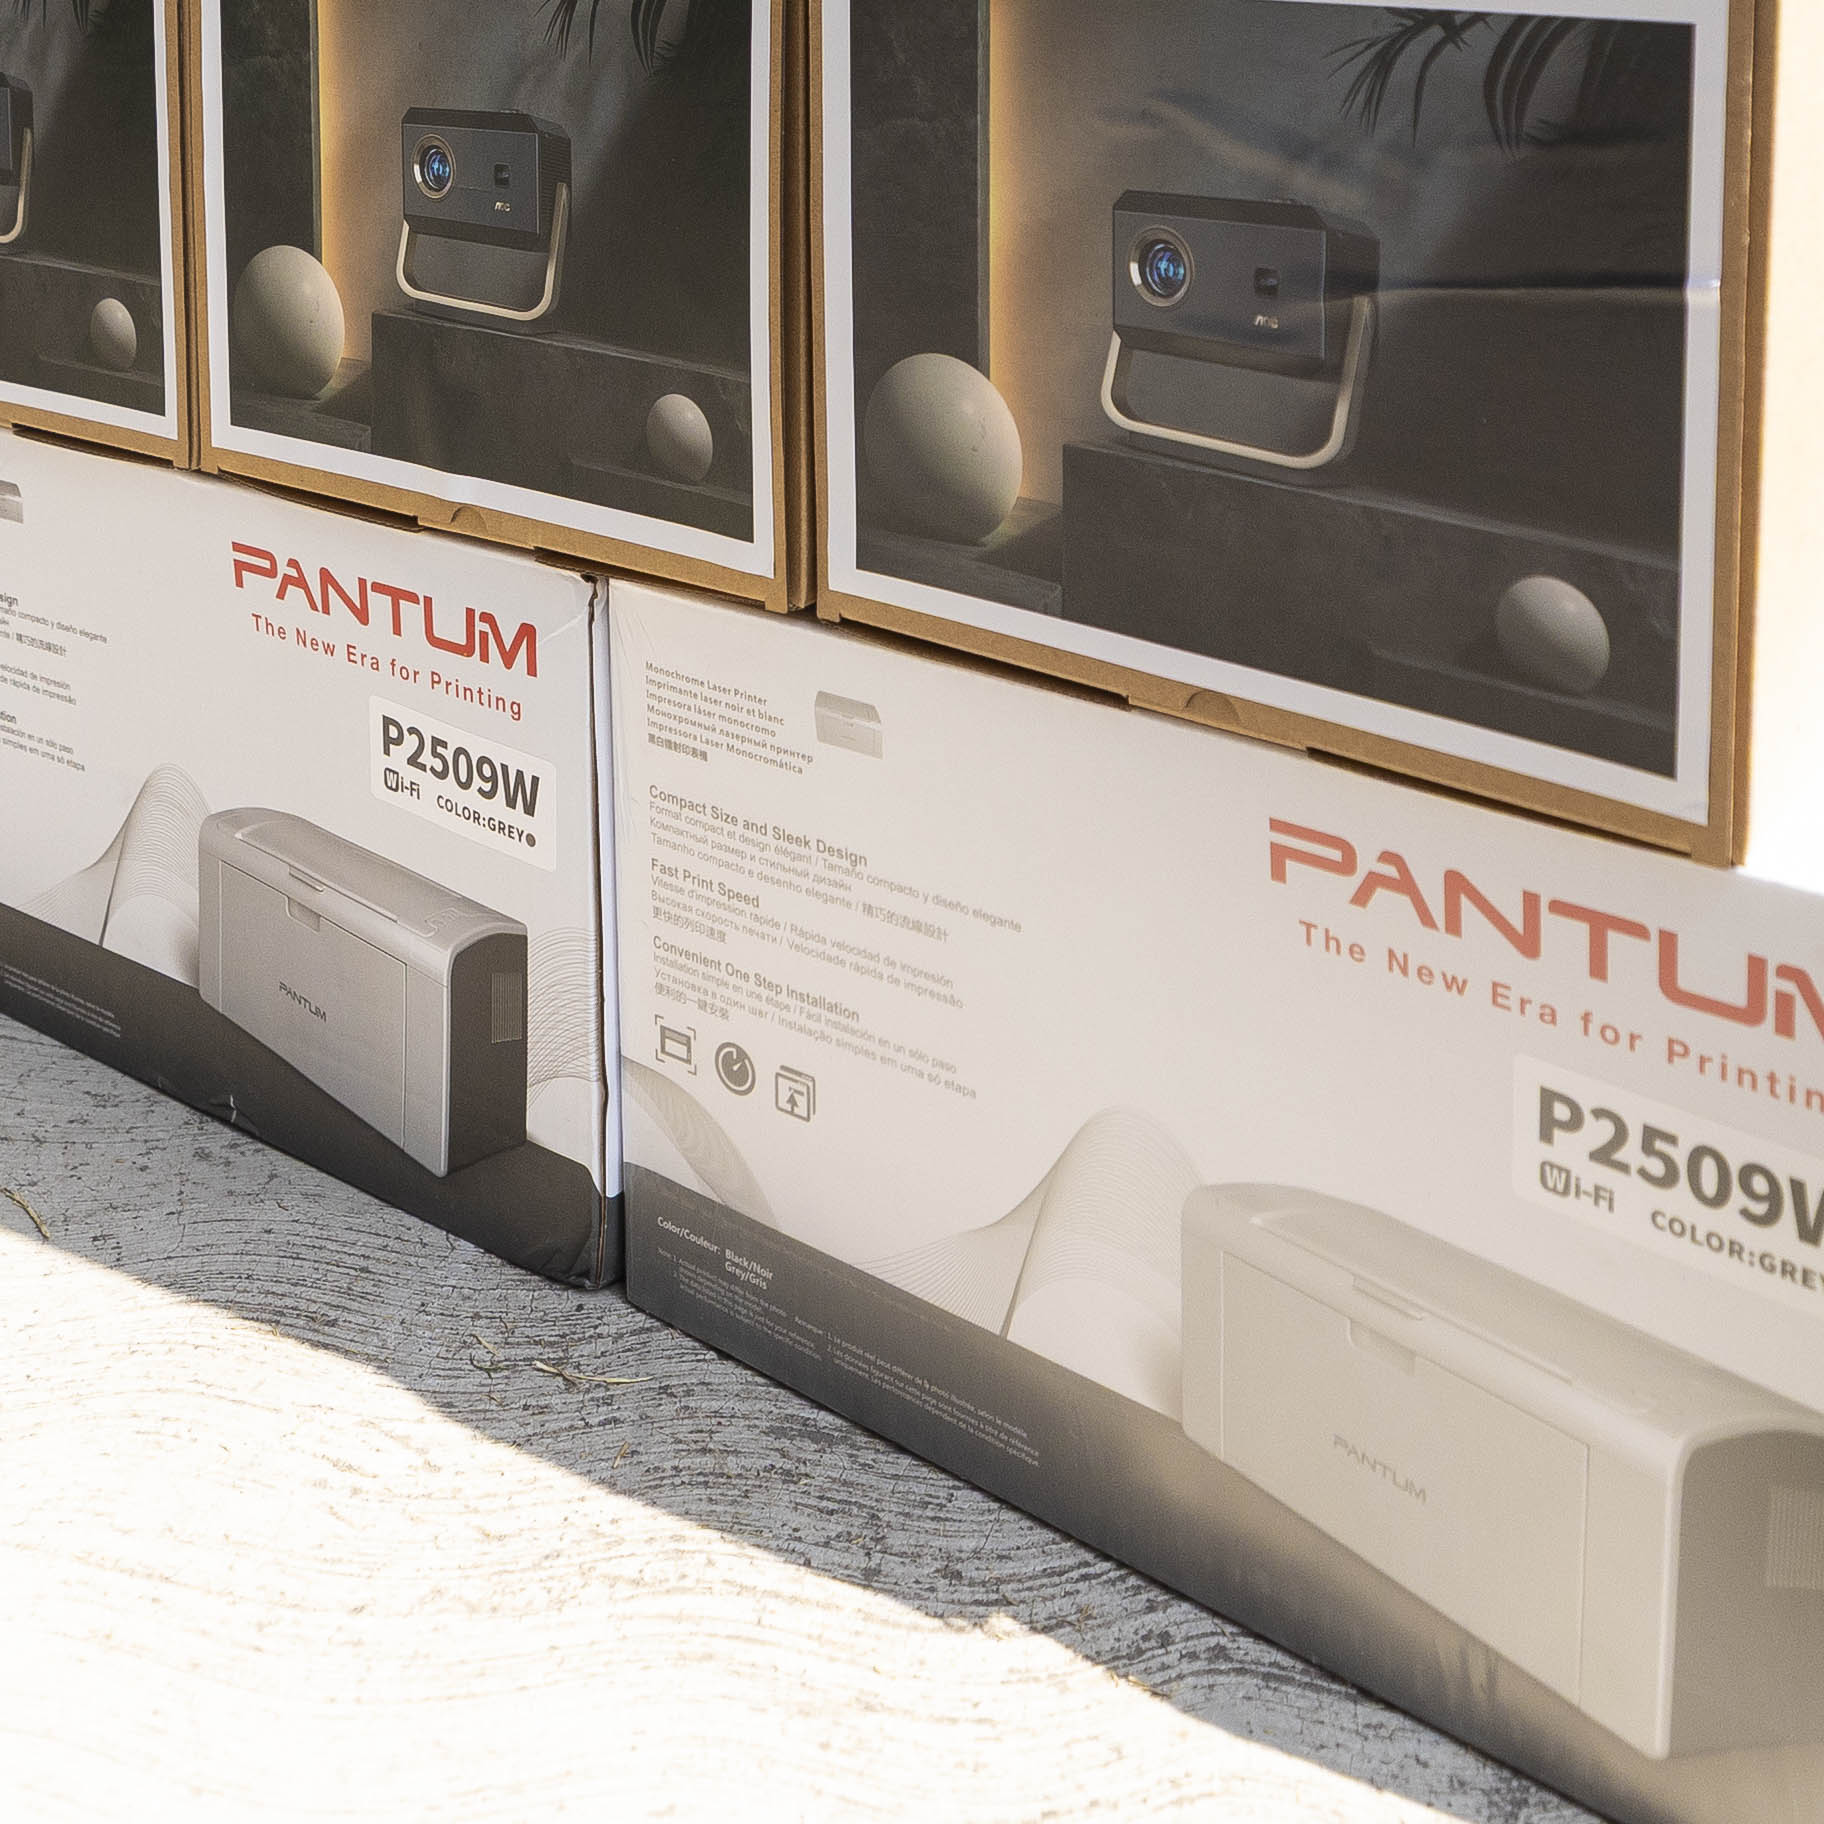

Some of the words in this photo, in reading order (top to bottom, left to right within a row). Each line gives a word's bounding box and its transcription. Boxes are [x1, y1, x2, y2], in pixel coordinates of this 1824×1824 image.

[232, 541, 537, 678] PANTUM
[252, 613, 286, 641] The
[296, 629, 335, 657] New
[347, 644, 380, 671] Era
[390, 658, 420, 684] for
[431, 672, 522, 721] Printing
[646, 662, 704, 687] Monochrome
[707, 680, 731, 695] Laser
[734, 689, 767, 706] Printer
[646, 675, 698, 699] Imprimante
[700, 692, 722, 707] laser
[725, 701, 744, 714] noir
[746, 707, 756, 717] et
[758, 709, 784, 726] blanc
[646, 690, 693, 712] Impresora
[694, 703, 717, 720] láser
[719, 713, 776, 738] monocromo
[382, 714, 539, 818] P2509W
[647, 718, 698, 742] Impressora
[699, 734, 724, 750] Laser
[726, 742, 803, 774] Monocromática
[384, 767, 420, 801] Wi-Fi
[650, 785, 707, 816] Compact
[711, 805, 738, 826] Size
[743, 818, 767, 835] and
[773, 825, 811, 849] Sleek
[816, 839, 867, 868] Design
[651, 858, 679, 881] Fast
[683, 869, 714, 893] Print
[718, 882, 760, 908] Speed
[278, 981, 328, 1024] PANTUM
[653, 936, 722, 972] Convenient
[725, 962, 750, 982] One
[753, 972, 782, 996] Step
[787, 984, 860, 1021] Installation
[1298, 920, 1367, 964] The
[1387, 947, 1469, 997] New
[1491, 981, 1558, 1028] Era
[1580, 1008, 1642, 1053] for
[1540, 1160, 1615, 1215] Wi-Fi
[657, 1216, 721, 1255] Color/Couleur:
[725, 1248, 774, 1280] Black/Noir
[724, 1261, 767, 1290] Grey/Gris
[1333, 1434, 1428, 1504] PANTUM
